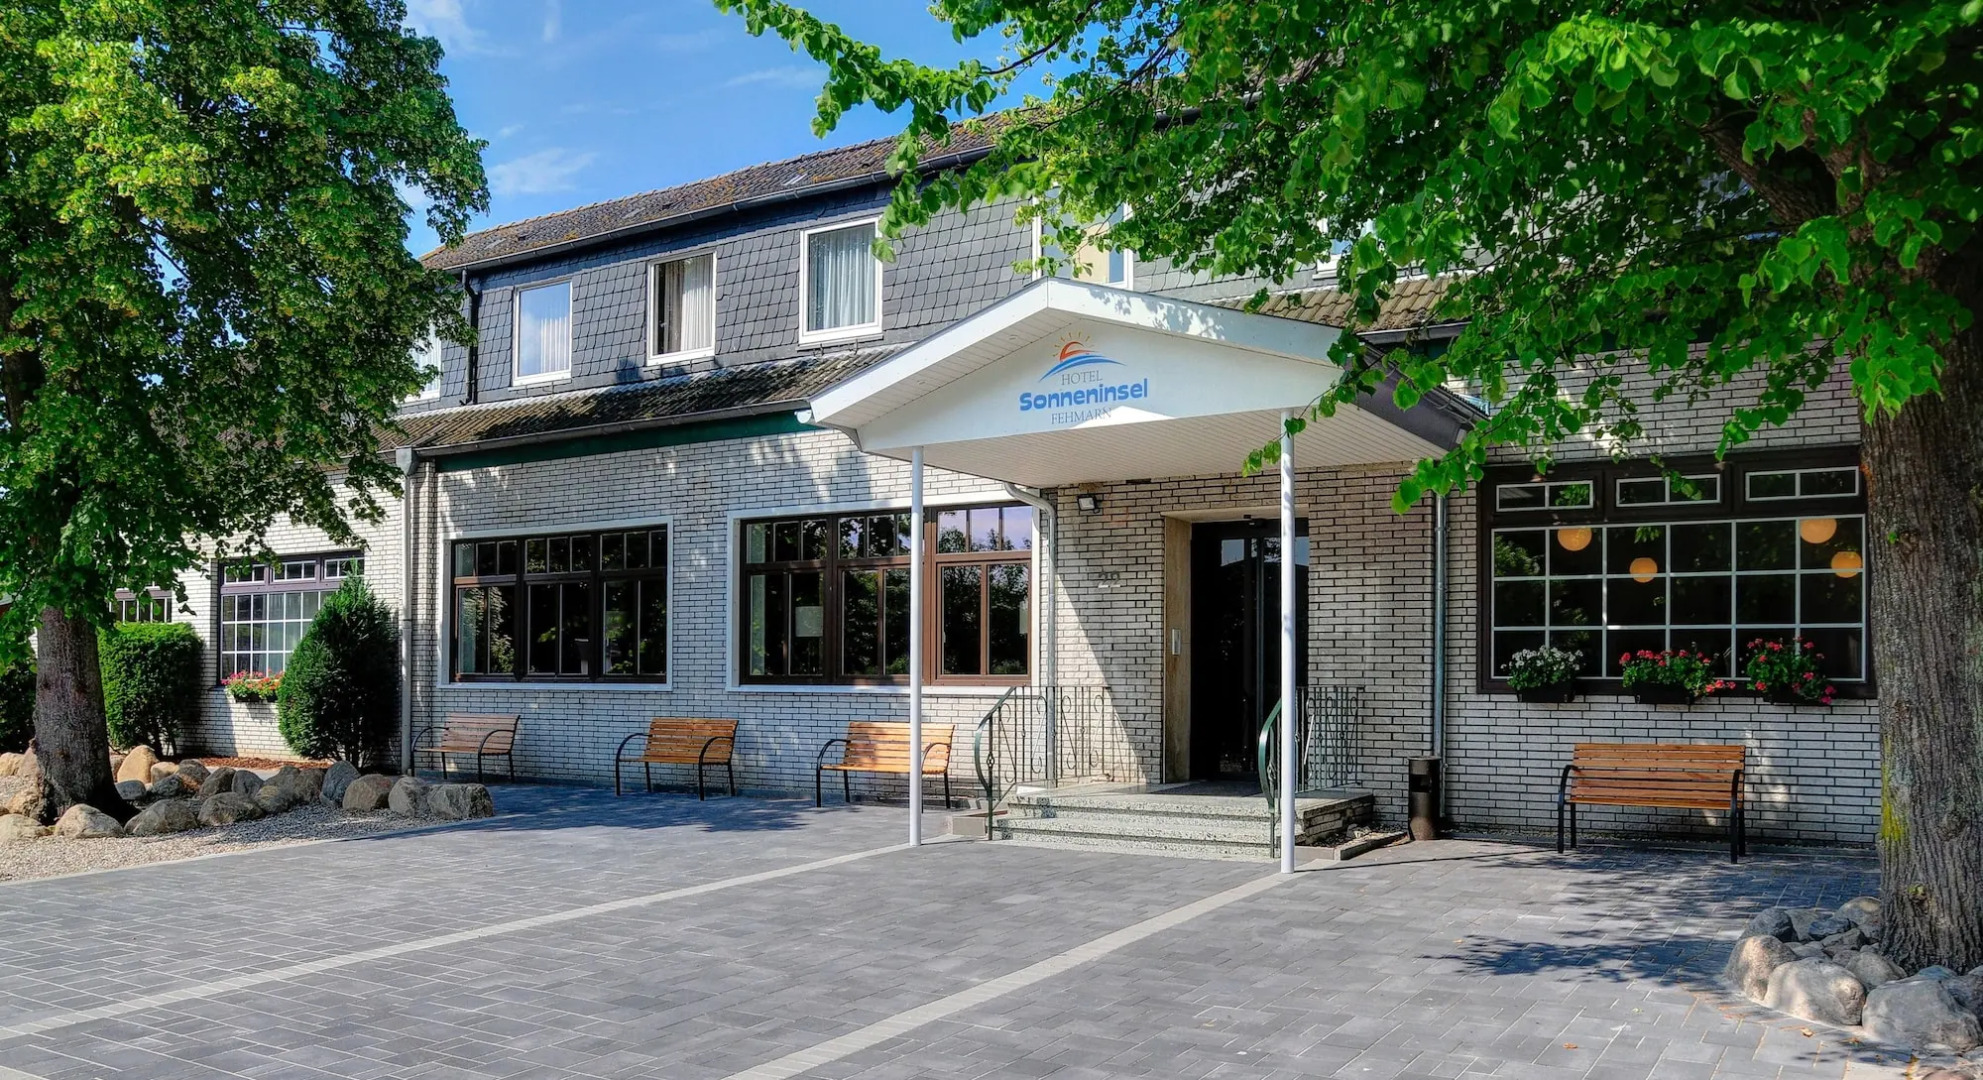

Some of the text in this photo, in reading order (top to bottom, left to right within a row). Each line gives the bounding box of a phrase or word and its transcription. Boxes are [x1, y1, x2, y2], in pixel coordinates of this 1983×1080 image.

[1061, 370, 1103, 385] HOTEL
[1019, 378, 1148, 411] Sonneninsel
[1051, 406, 1112, 424] FEHMARN
